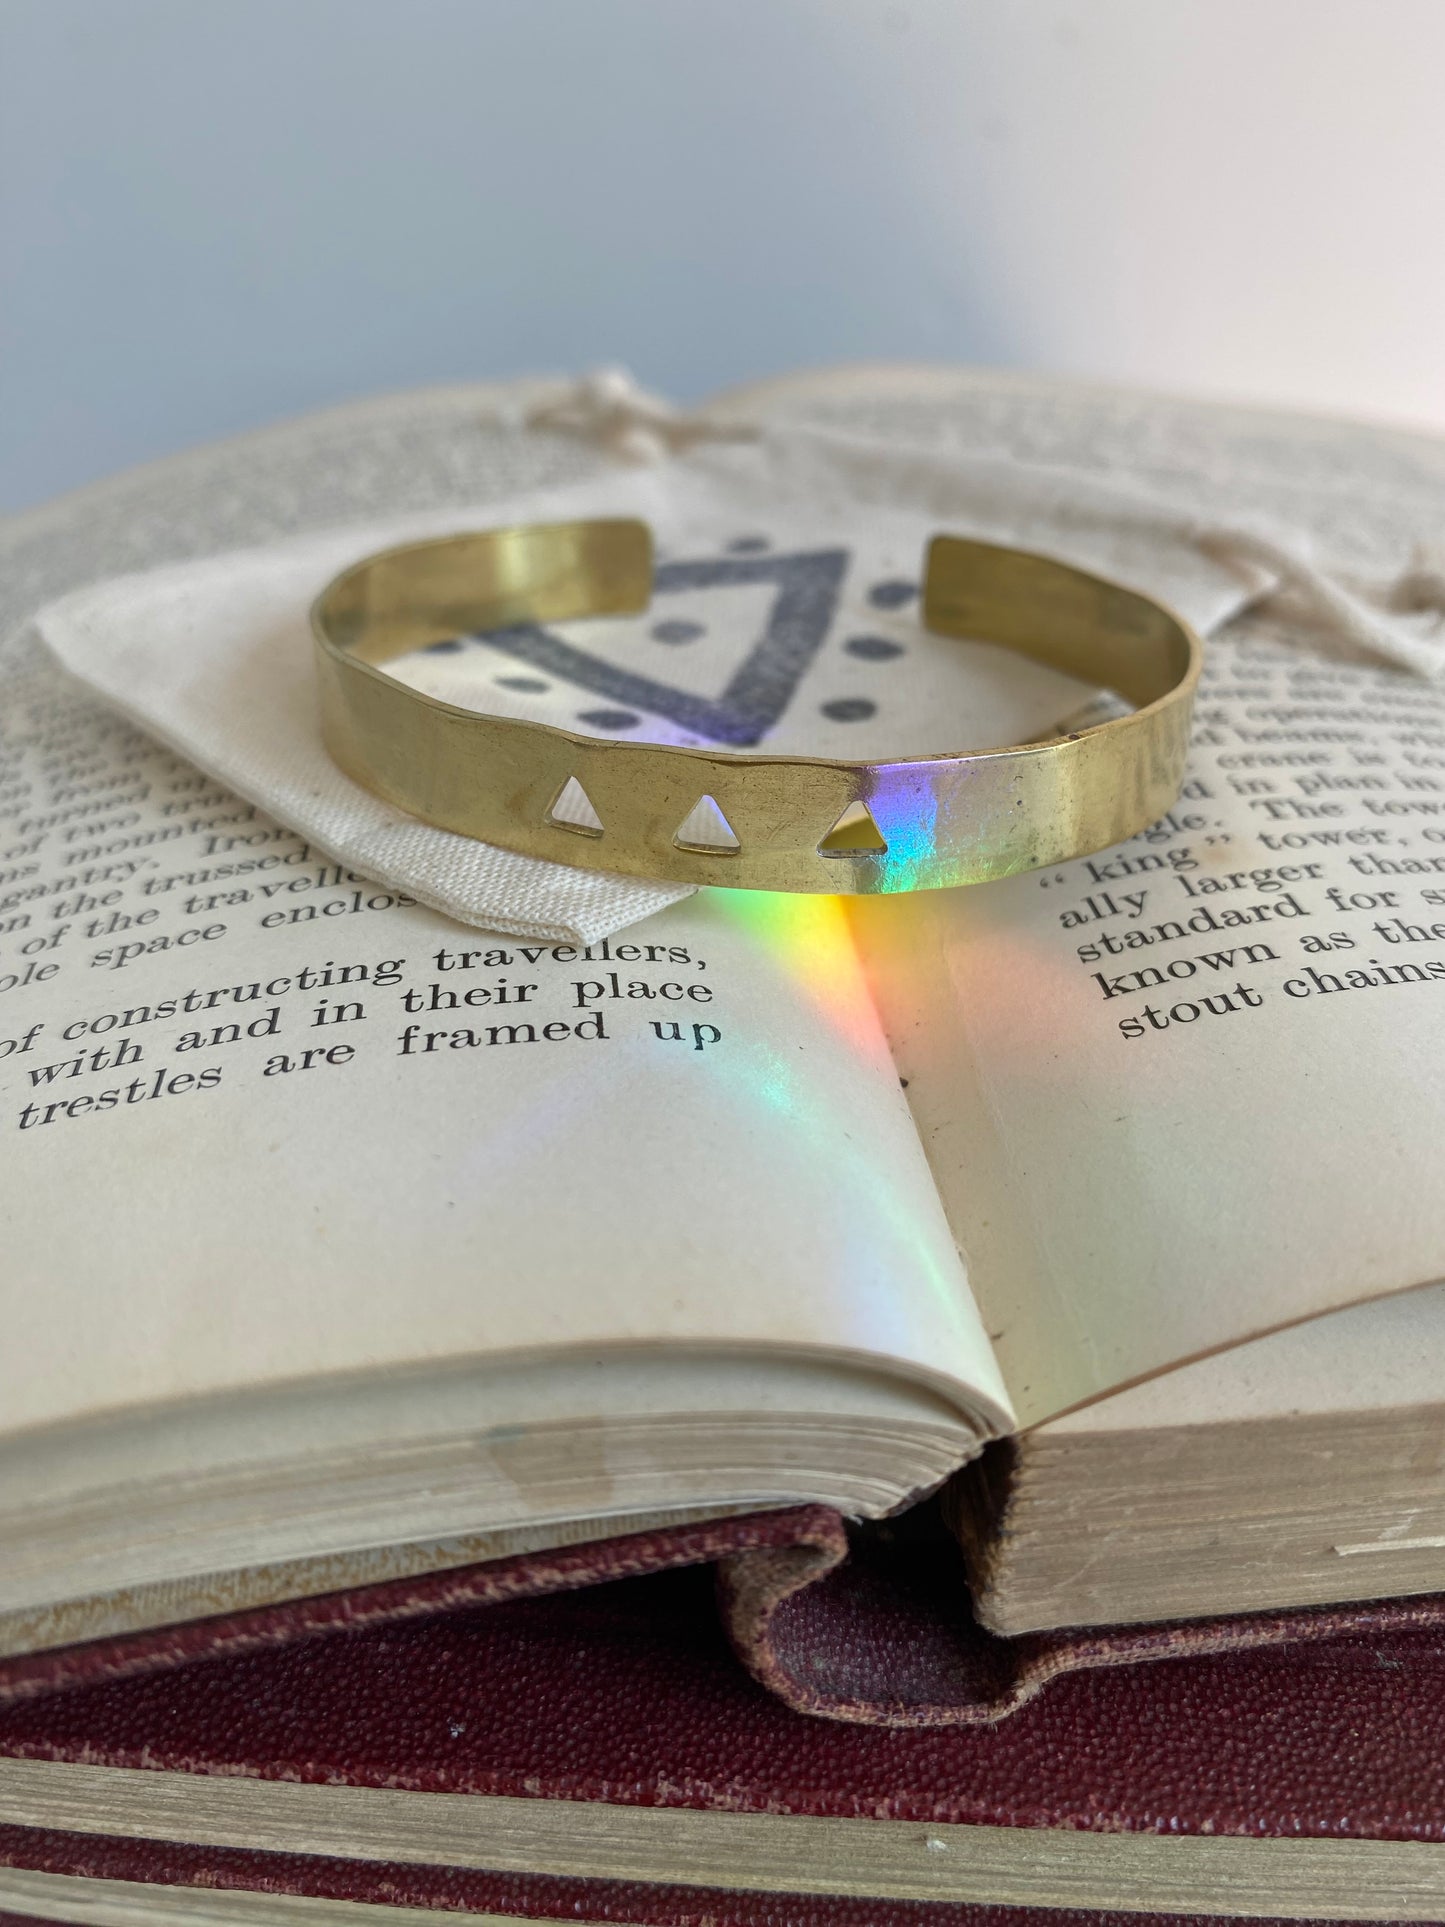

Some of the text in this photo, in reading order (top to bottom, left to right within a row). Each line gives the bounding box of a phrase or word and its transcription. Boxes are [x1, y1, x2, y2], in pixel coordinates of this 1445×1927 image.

[63, 804, 258, 867] mounted
[1250, 799, 1345, 820] The
[1362, 799, 1445, 816] tow
[0, 854, 160, 912] gantry.
[53, 887, 123, 920] the
[143, 844, 311, 896] trussed
[1060, 890, 1148, 929] ally
[1173, 862, 1323, 899] larger
[21, 926, 69, 956] of
[86, 907, 160, 939] the
[90, 922, 227, 971] space
[1077, 887, 1445, 963] standard for s
[1091, 942, 1281, 1000] known
[1299, 932, 1356, 954] as
[1118, 958, 1445, 1040] stout chains
[0, 1023, 45, 1059] of
[62, 958, 407, 1041] constructing
[27, 972, 713, 1087] with and in their place
[18, 1011, 722, 1130] trestles are framed up
